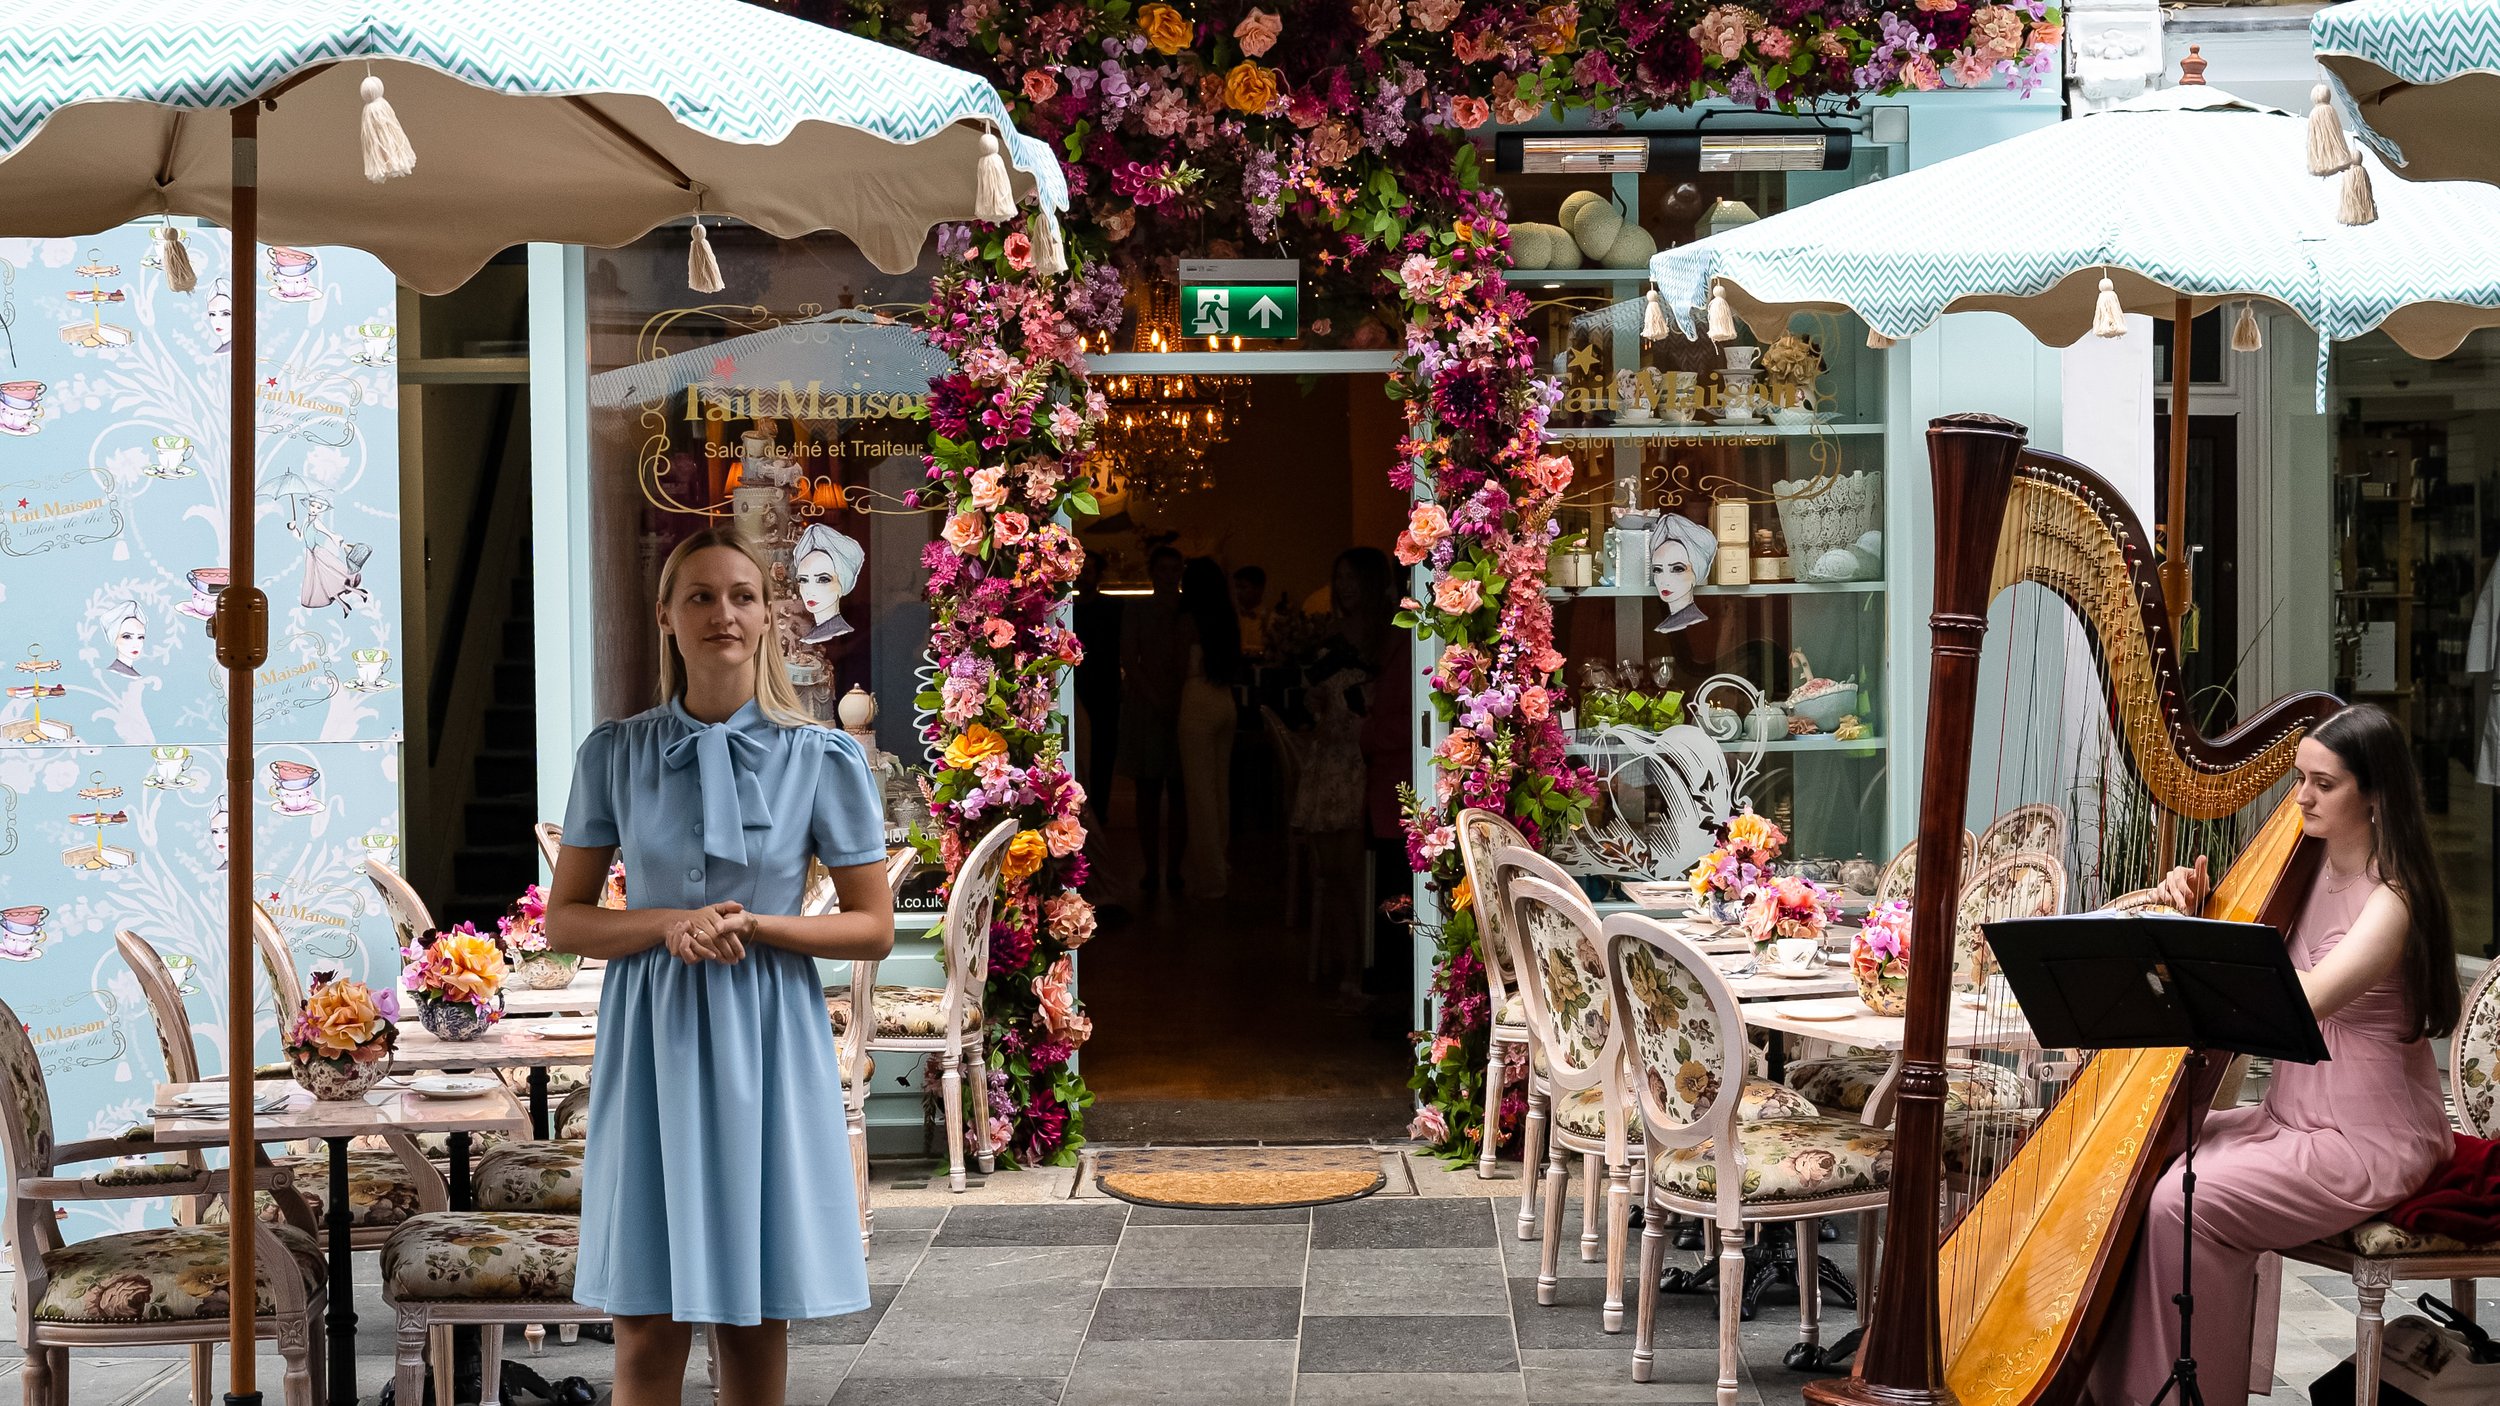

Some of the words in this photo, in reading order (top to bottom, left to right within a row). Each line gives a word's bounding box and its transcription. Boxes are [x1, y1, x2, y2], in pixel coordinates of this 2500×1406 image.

[1632, 370, 1796, 410] Maison
[285, 390, 344, 416] Maison
[763, 440, 787, 458] de
[793, 440, 821, 457] thé
[828, 442, 846, 457] et
[851, 440, 923, 457] Traiteur
[1563, 432, 1615, 449] Salon
[1623, 431, 1645, 448] de
[1651, 430, 1679, 448] thé
[1685, 432, 1703, 448] et
[1709, 430, 1780, 447] Traiteur
[10, 507, 40, 524] Fait
[43, 498, 103, 518] Maison
[260, 661, 317, 687] Maison
[896, 895, 943, 909] i.co.uk
[277, 920, 294, 932] lon
[287, 905, 346, 927] Maison
[45, 1020, 105, 1041] Maison
[39, 1047, 57, 1058] lon
